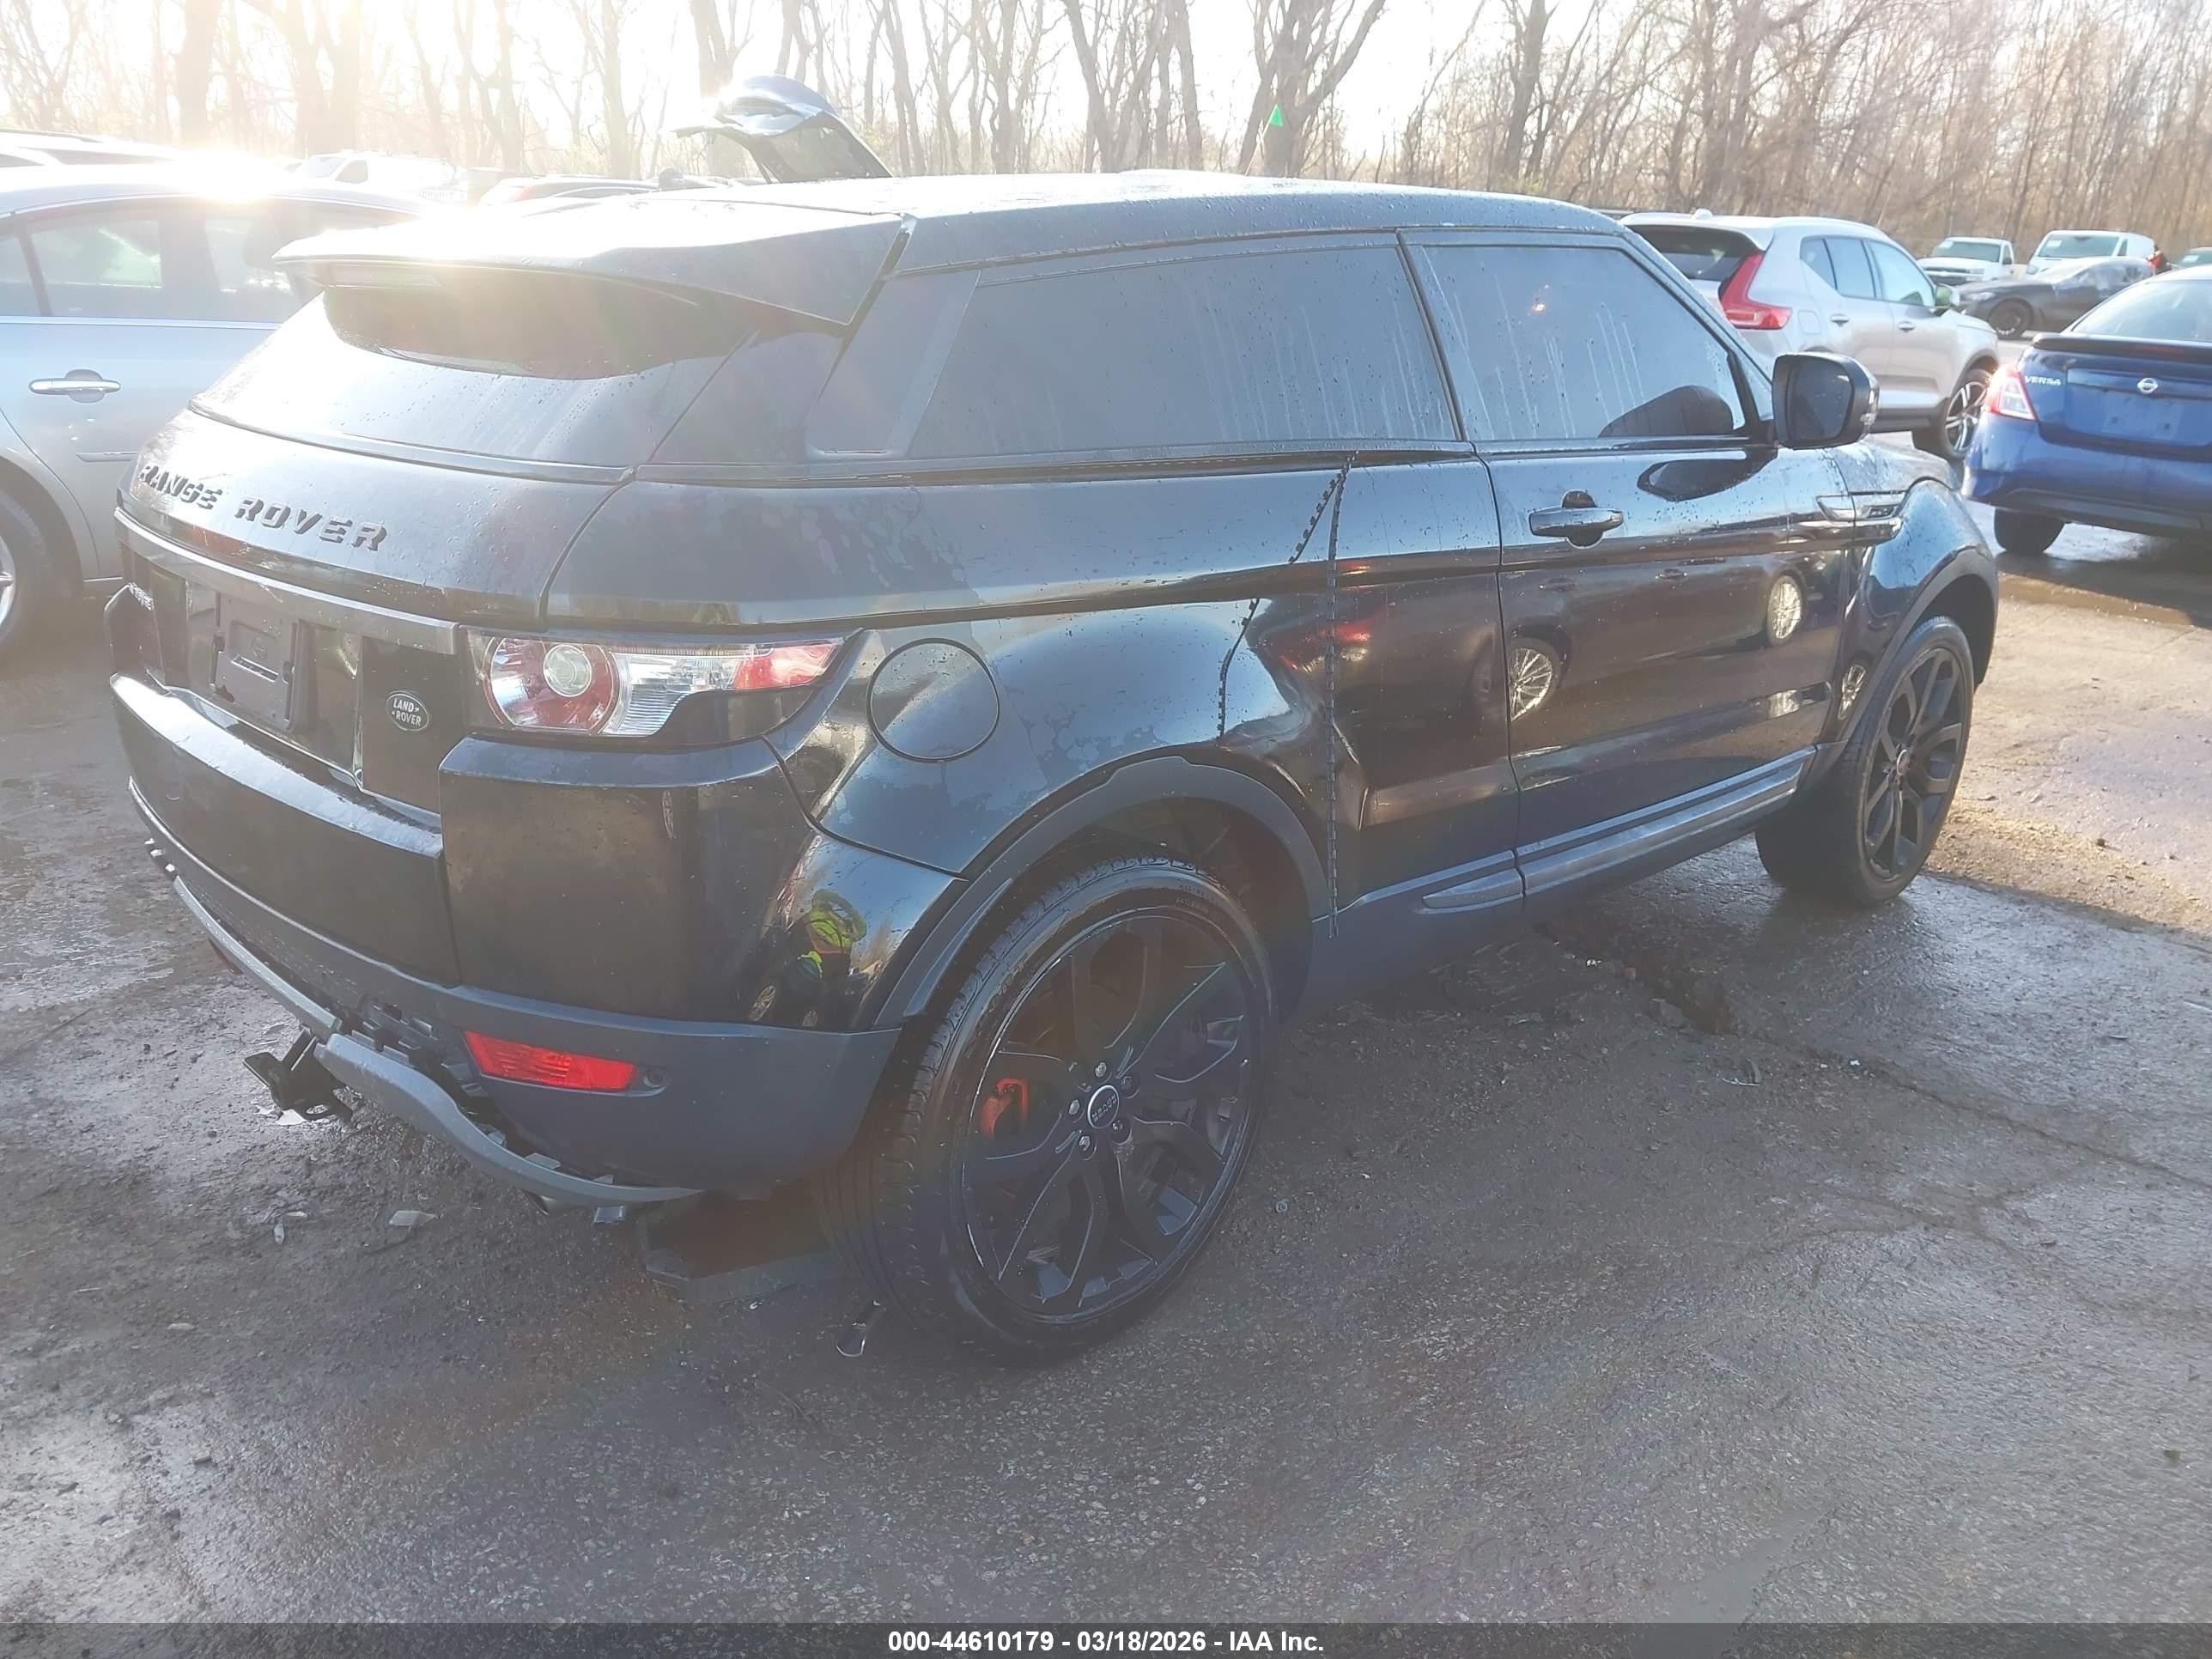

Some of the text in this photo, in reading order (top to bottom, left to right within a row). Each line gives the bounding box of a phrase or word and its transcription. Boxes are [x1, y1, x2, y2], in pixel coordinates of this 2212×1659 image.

[2025, 375, 2062, 386] VERSA
[137, 464, 387, 551] RANGE ROVER
[393, 698, 414, 712] LAND
[396, 710, 422, 726] ROVER
